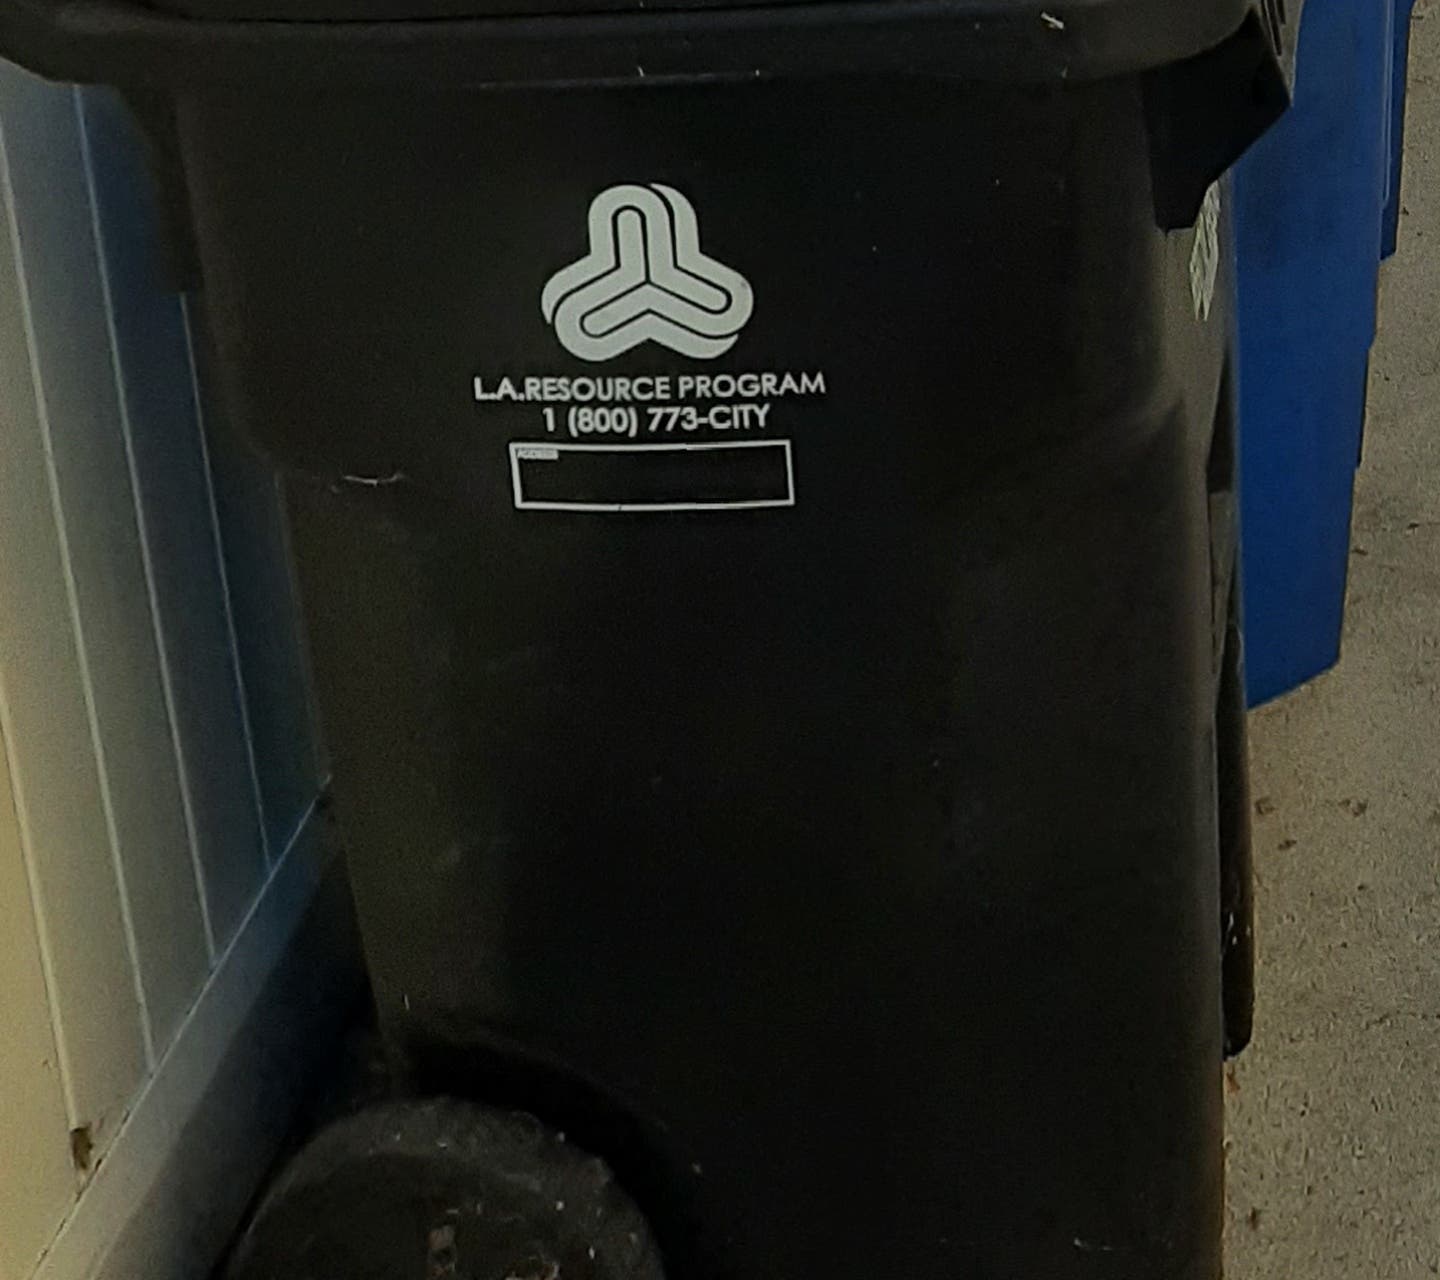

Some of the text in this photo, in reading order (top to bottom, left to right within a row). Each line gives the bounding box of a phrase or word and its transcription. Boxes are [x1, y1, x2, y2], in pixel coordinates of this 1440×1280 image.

[677, 372, 826, 399] PROGRAM
[542, 403, 770, 438] 1 (800) 773-CITY
